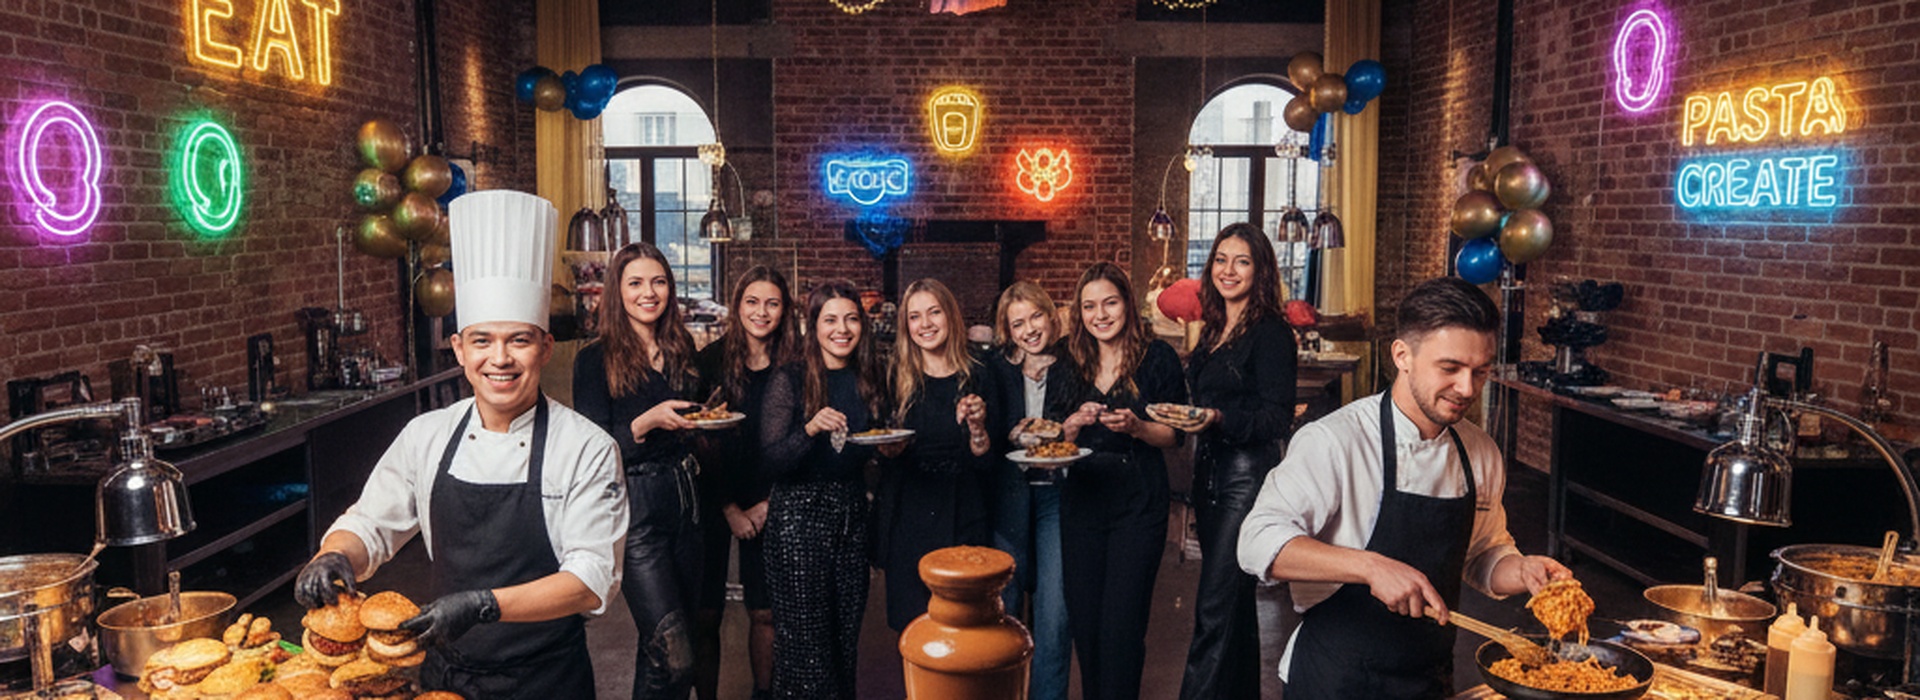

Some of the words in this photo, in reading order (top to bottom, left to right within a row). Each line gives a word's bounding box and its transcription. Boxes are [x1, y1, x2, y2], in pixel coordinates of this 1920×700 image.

[192, 0, 341, 86] EAT
[1682, 76, 1847, 147] PASTA
[1677, 154, 1838, 208] CREATE
